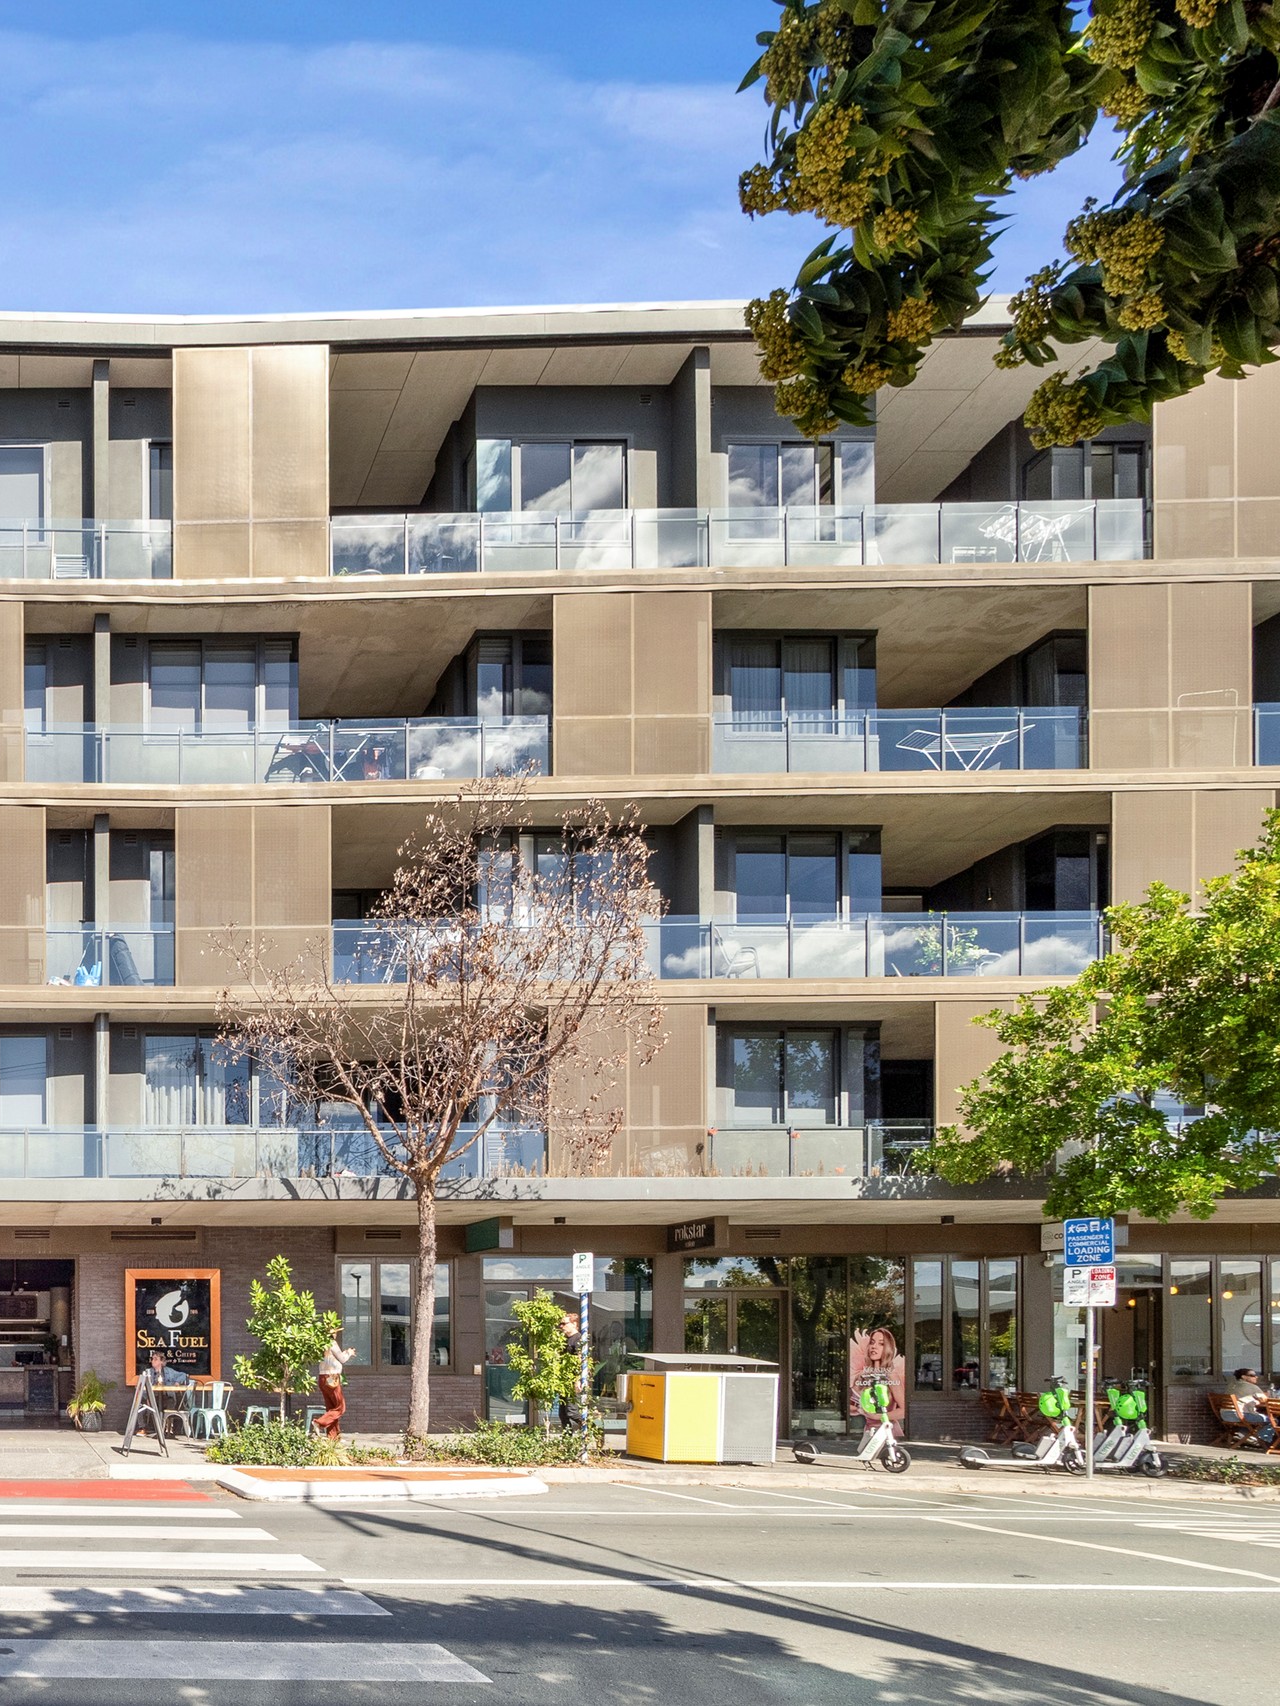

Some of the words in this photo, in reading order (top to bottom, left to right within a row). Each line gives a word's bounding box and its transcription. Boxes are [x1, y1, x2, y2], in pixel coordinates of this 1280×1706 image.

[674, 1223, 707, 1242] rokstar
[1067, 1234, 1104, 1242] PASSENGER
[1067, 1246, 1110, 1255] LOADING
[1076, 1254, 1102, 1263] ZONE
[1072, 1269, 1081, 1279] P
[136, 1329, 167, 1348] SEA
[168, 1329, 208, 1348] FUEL
